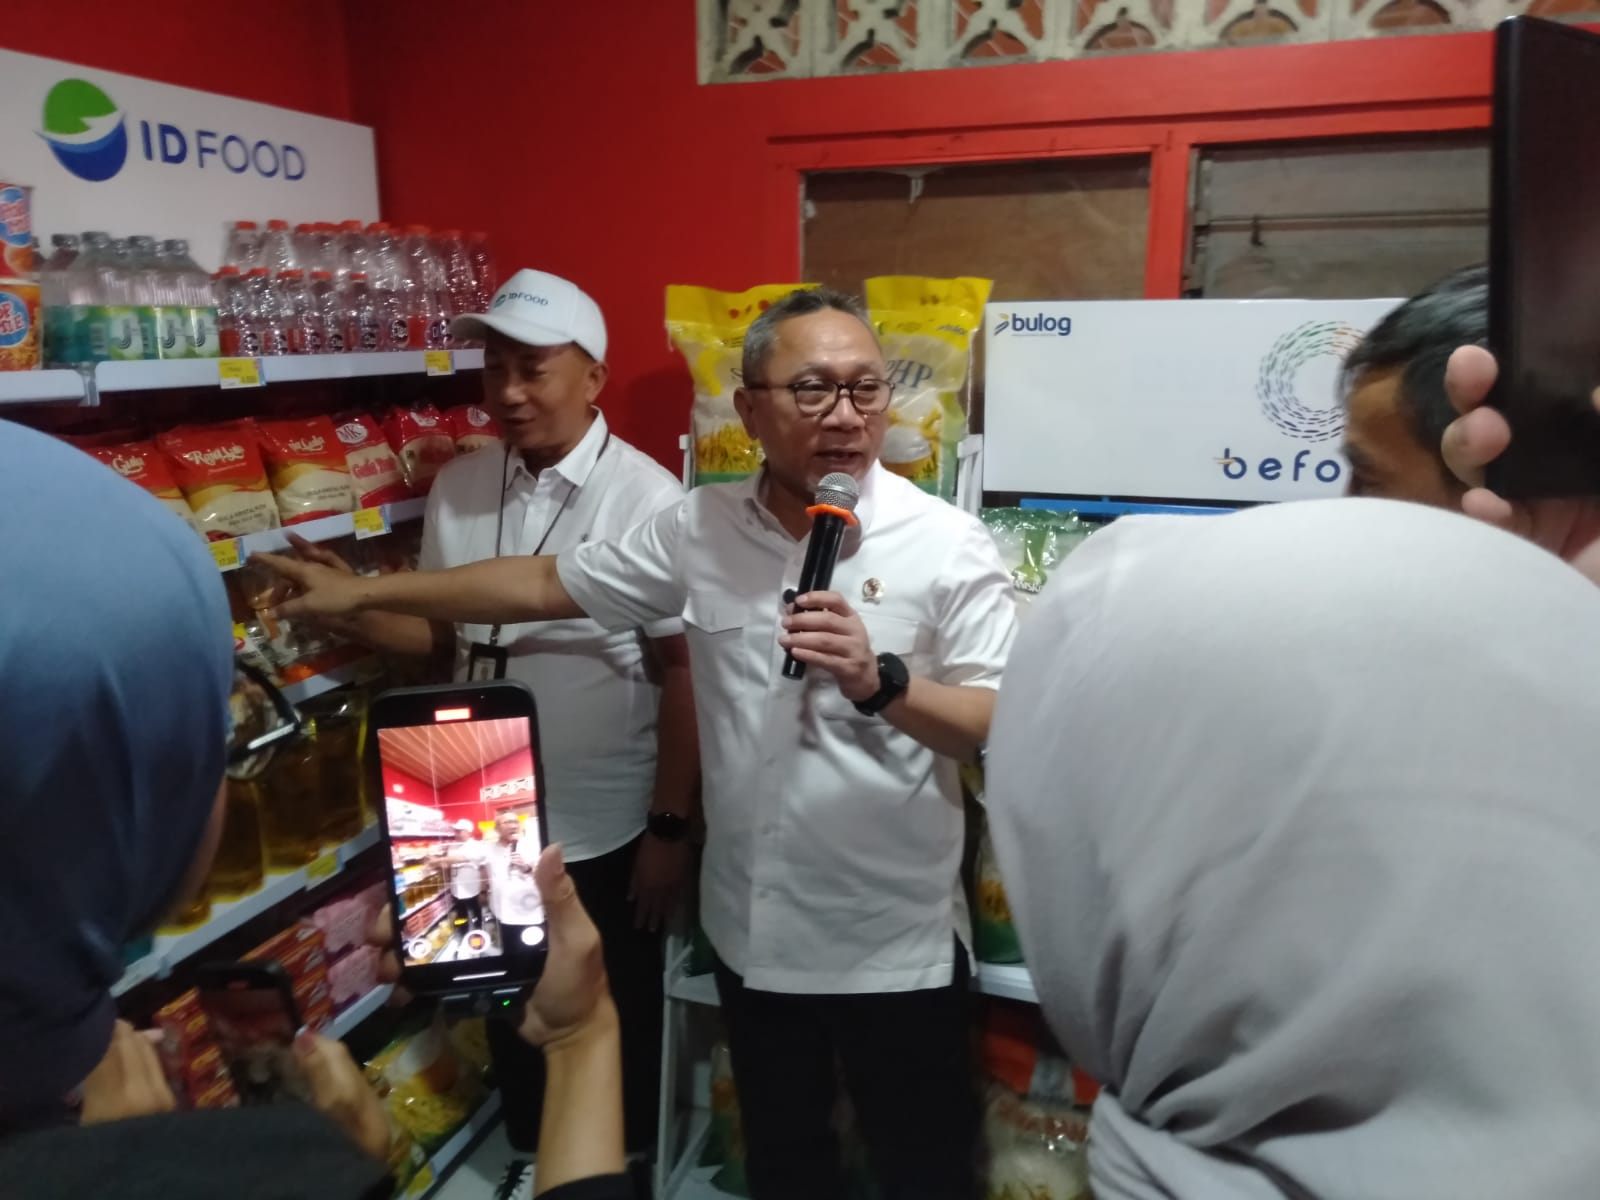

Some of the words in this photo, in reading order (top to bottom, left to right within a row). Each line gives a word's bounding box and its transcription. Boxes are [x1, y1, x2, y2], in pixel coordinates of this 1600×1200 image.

[140, 120, 187, 164] ID
[196, 130, 305, 180] FOOD
[1012, 313, 1071, 336] bulog
